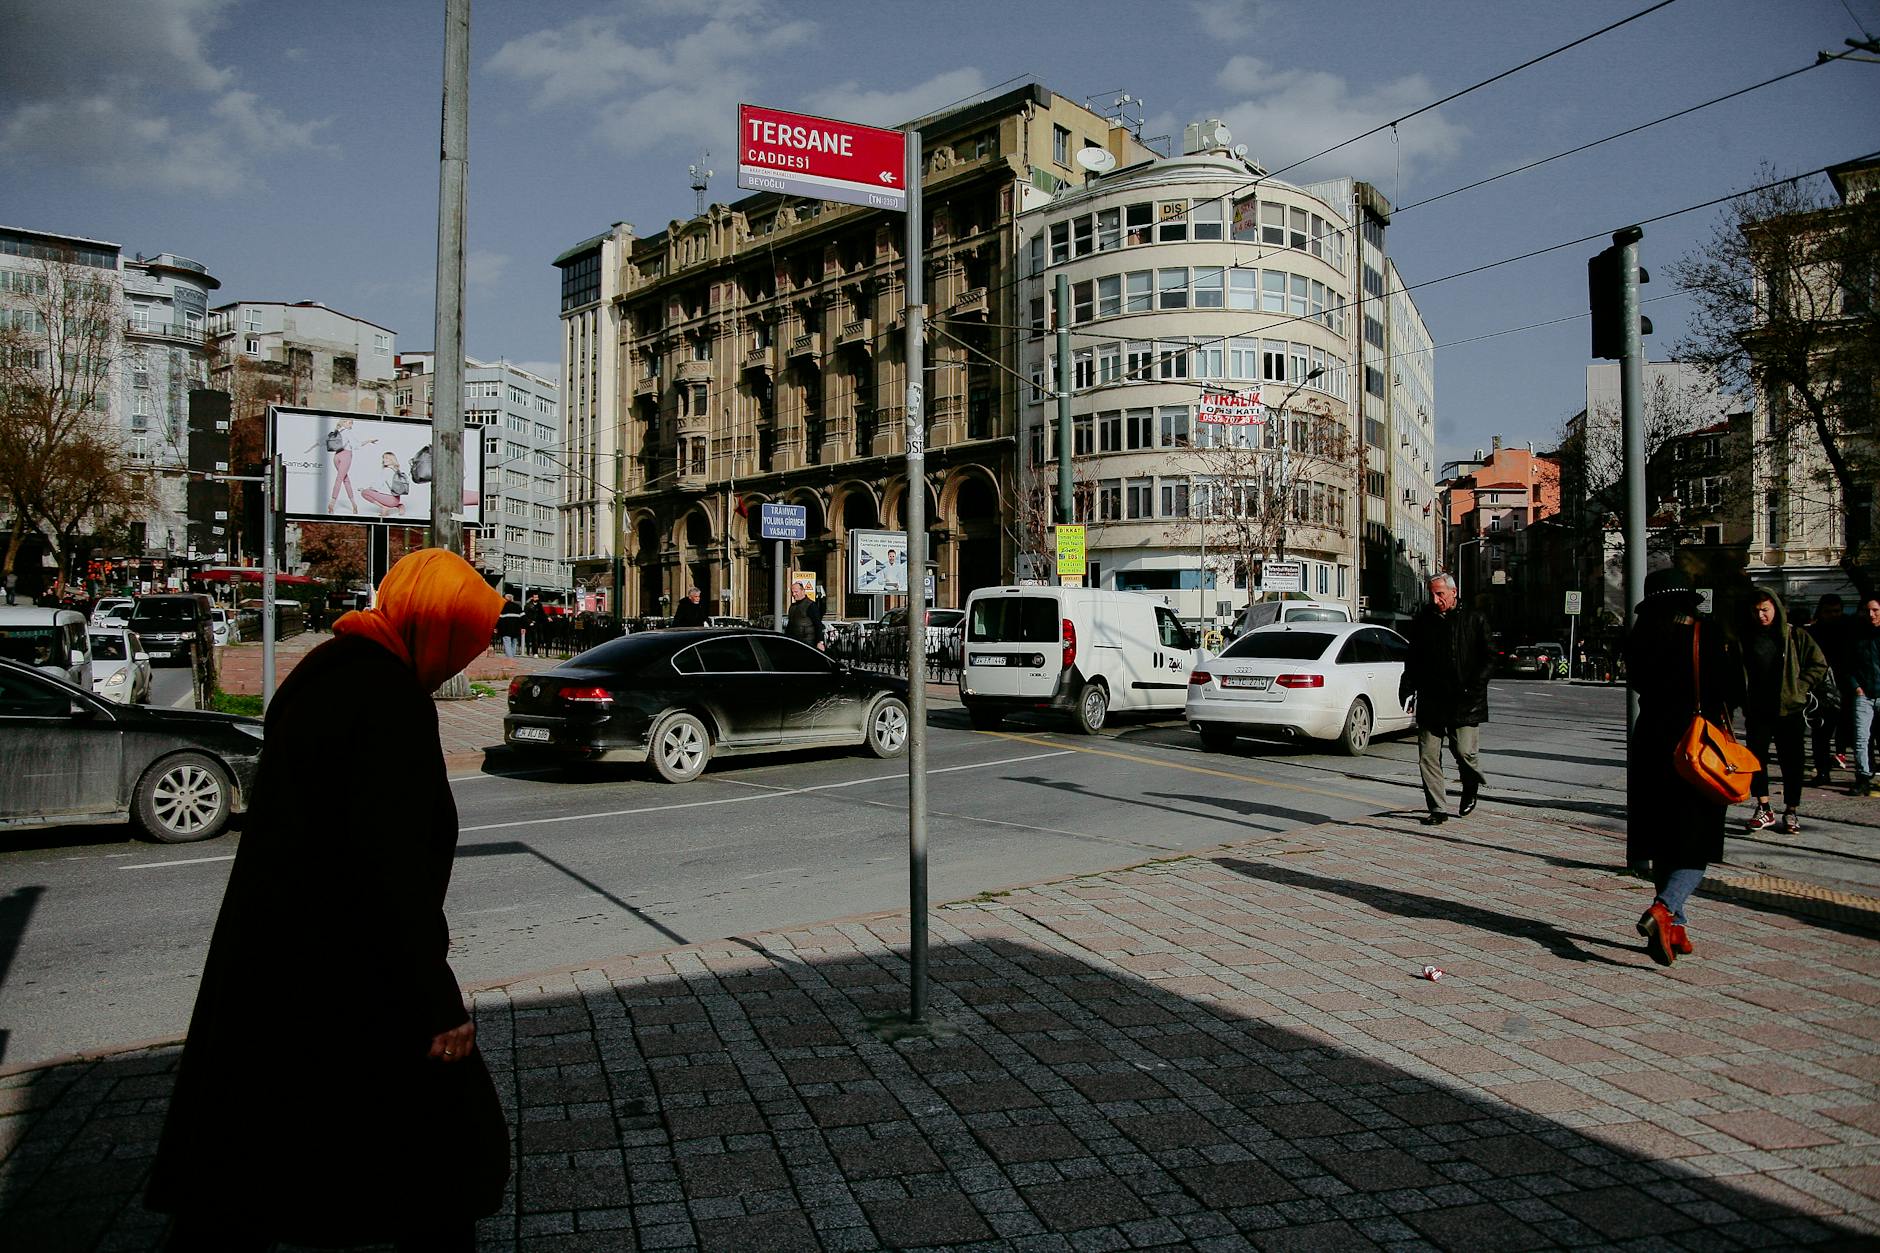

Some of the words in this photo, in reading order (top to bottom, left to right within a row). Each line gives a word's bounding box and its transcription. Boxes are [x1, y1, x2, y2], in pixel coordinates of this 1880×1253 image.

[748, 119, 853, 157] TERSANE
[748, 149, 810, 170] CADDESİ
[748, 176, 785, 190] BEYOĞLU
[771, 506, 797, 516] TRAMVAY
[769, 527, 797, 537] YASAKTIR
